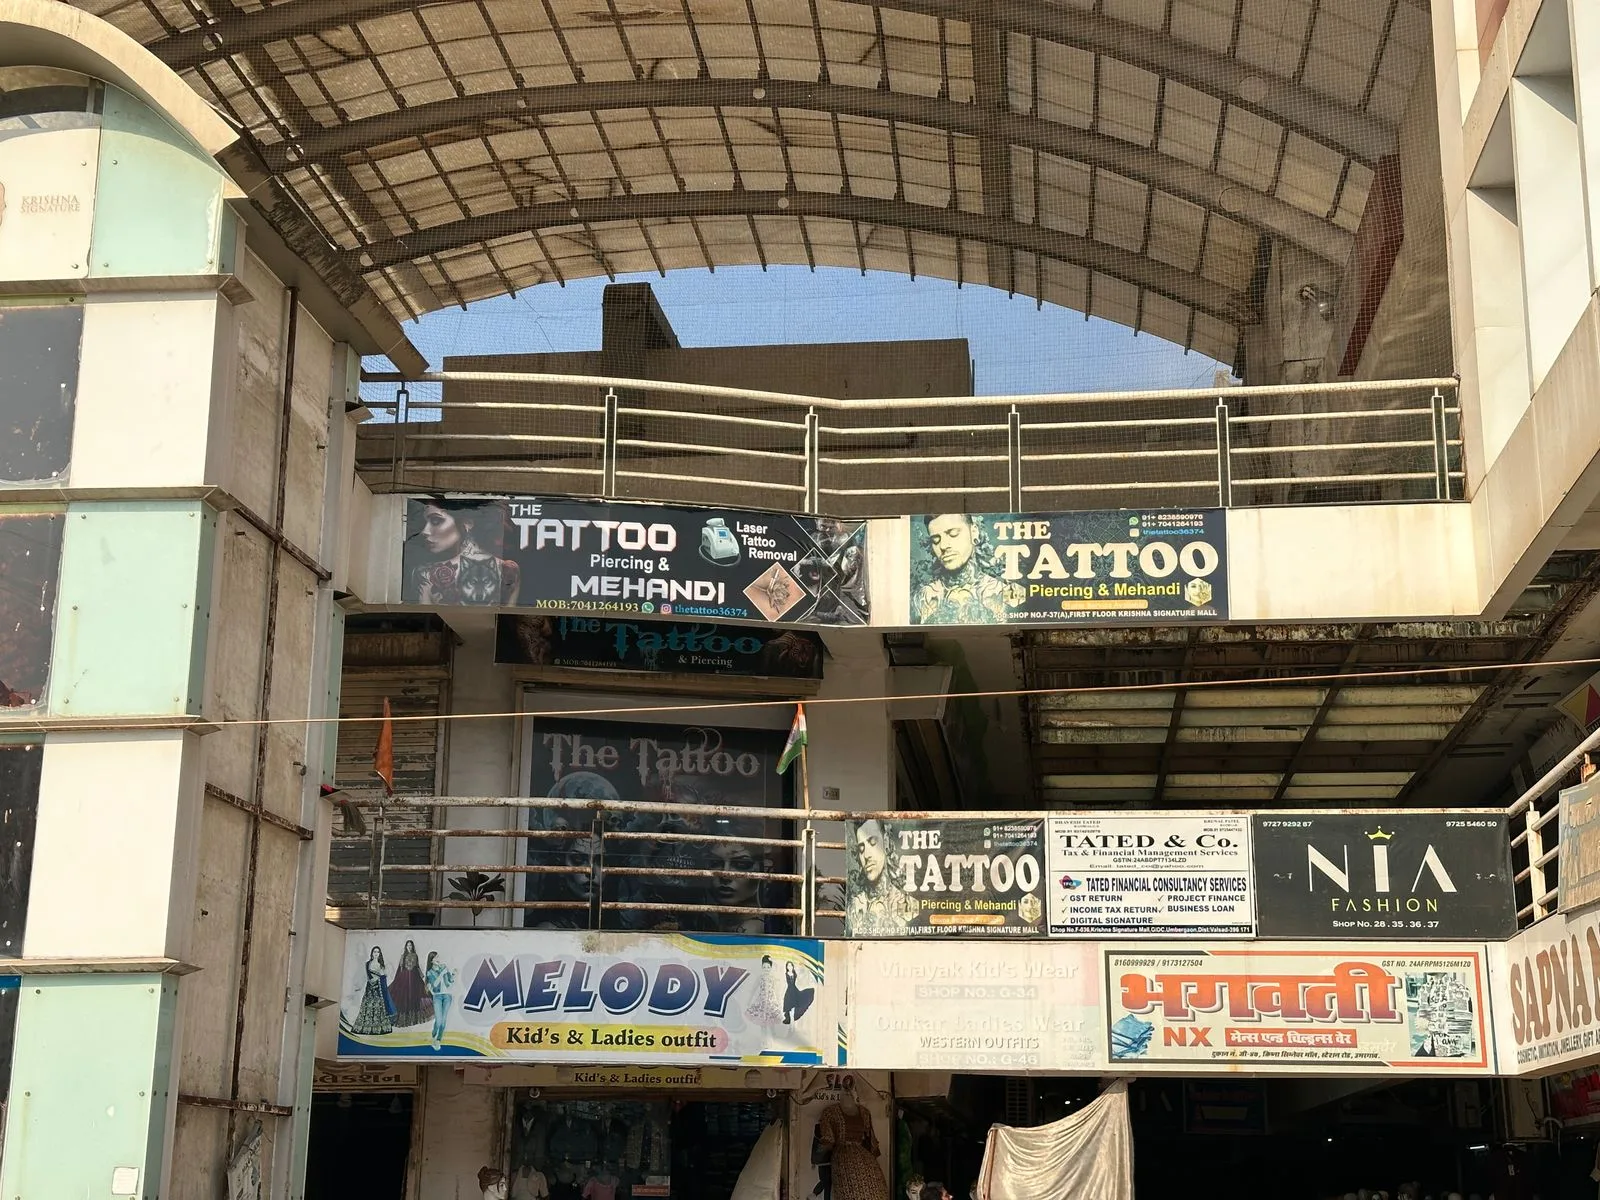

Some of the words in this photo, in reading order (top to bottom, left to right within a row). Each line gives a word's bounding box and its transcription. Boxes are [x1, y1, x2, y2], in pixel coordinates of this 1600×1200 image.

[22, 194, 80, 206] KRISHNA
[20, 203, 81, 214] SIGNATURE
[509, 503, 542, 516] THE
[736, 521, 768, 534] Laser
[993, 520, 1052, 540] THE
[511, 518, 678, 553] TATTOO
[741, 535, 776, 548] Tattoo
[748, 547, 797, 562] Removal
[994, 541, 1219, 580] TATTOO
[590, 553, 653, 574] Piercing
[658, 557, 670, 571] &
[571, 575, 725, 604] MEHANDI
[1029, 584, 1093, 599] Piercing
[1098, 583, 1109, 596] &
[1114, 582, 1180, 596] Mehandi
[675, 603, 747, 617] thetattoo36374
[1092, 610, 1116, 618] FLOOR
[1153, 609, 1195, 617] SIGNATURE
[557, 616, 601, 640] The
[604, 622, 764, 660] Tattoo
[678, 655, 687, 664] &
[691, 655, 733, 668] Piercing
[543, 733, 620, 782] The
[629, 728, 761, 787] Tattoo
[898, 830, 942, 850] THE
[1060, 835, 1155, 848] TATED
[1164, 834, 1186, 848] &
[1196, 834, 1239, 848] Co.
[899, 854, 1040, 892] TATTOO
[1307, 844, 1457, 892] NIA
[1086, 877, 1109, 892] TATED
[1112, 877, 1151, 892] FINANCIAL
[1153, 877, 1208, 892] CONSULTANCY
[1210, 877, 1247, 892] SERVICES
[921, 899, 962, 912] Piercing
[965, 900, 972, 910] &
[974, 899, 1016, 911] Mehandi
[1332, 898, 1438, 912] FASHION
[937, 926, 957, 934] FLOOR
[958, 925, 985, 933] KRISHNA
[1162, 959, 1203, 967] 9173127504
[1396, 960, 1407, 968] NO.
[880, 962, 962, 982] Vinayak
[969, 961, 1017, 978] Kid's
[1023, 961, 1079, 979] Wear
[464, 958, 751, 1017] MELODY
[918, 986, 960, 998] SHOP
[1000, 986, 1035, 998] G-34
[1120, 961, 1401, 1021] भगवती
[1510, 934, 1592, 1046] SAPNA
[1035, 1015, 1085, 1033] Wear
[506, 1026, 560, 1046] Kid's
[567, 1028, 583, 1045] &
[591, 1027, 655, 1047] Ladies
[660, 1029, 717, 1048] outfit
[920, 1036, 981, 1049] WESTERN
[985, 1036, 1040, 1049] OUTFITS
[1163, 1027, 1213, 1047] NX
[1230, 1030, 1259, 1043] मेन्स
[1261, 1033, 1285, 1044] एन्ड
[1335, 1031, 1352, 1044] वेर
[575, 1072, 606, 1083] Kid's
[610, 1073, 619, 1083] &
[624, 1073, 661, 1084] Ladies
[665, 1073, 698, 1084] outfit
